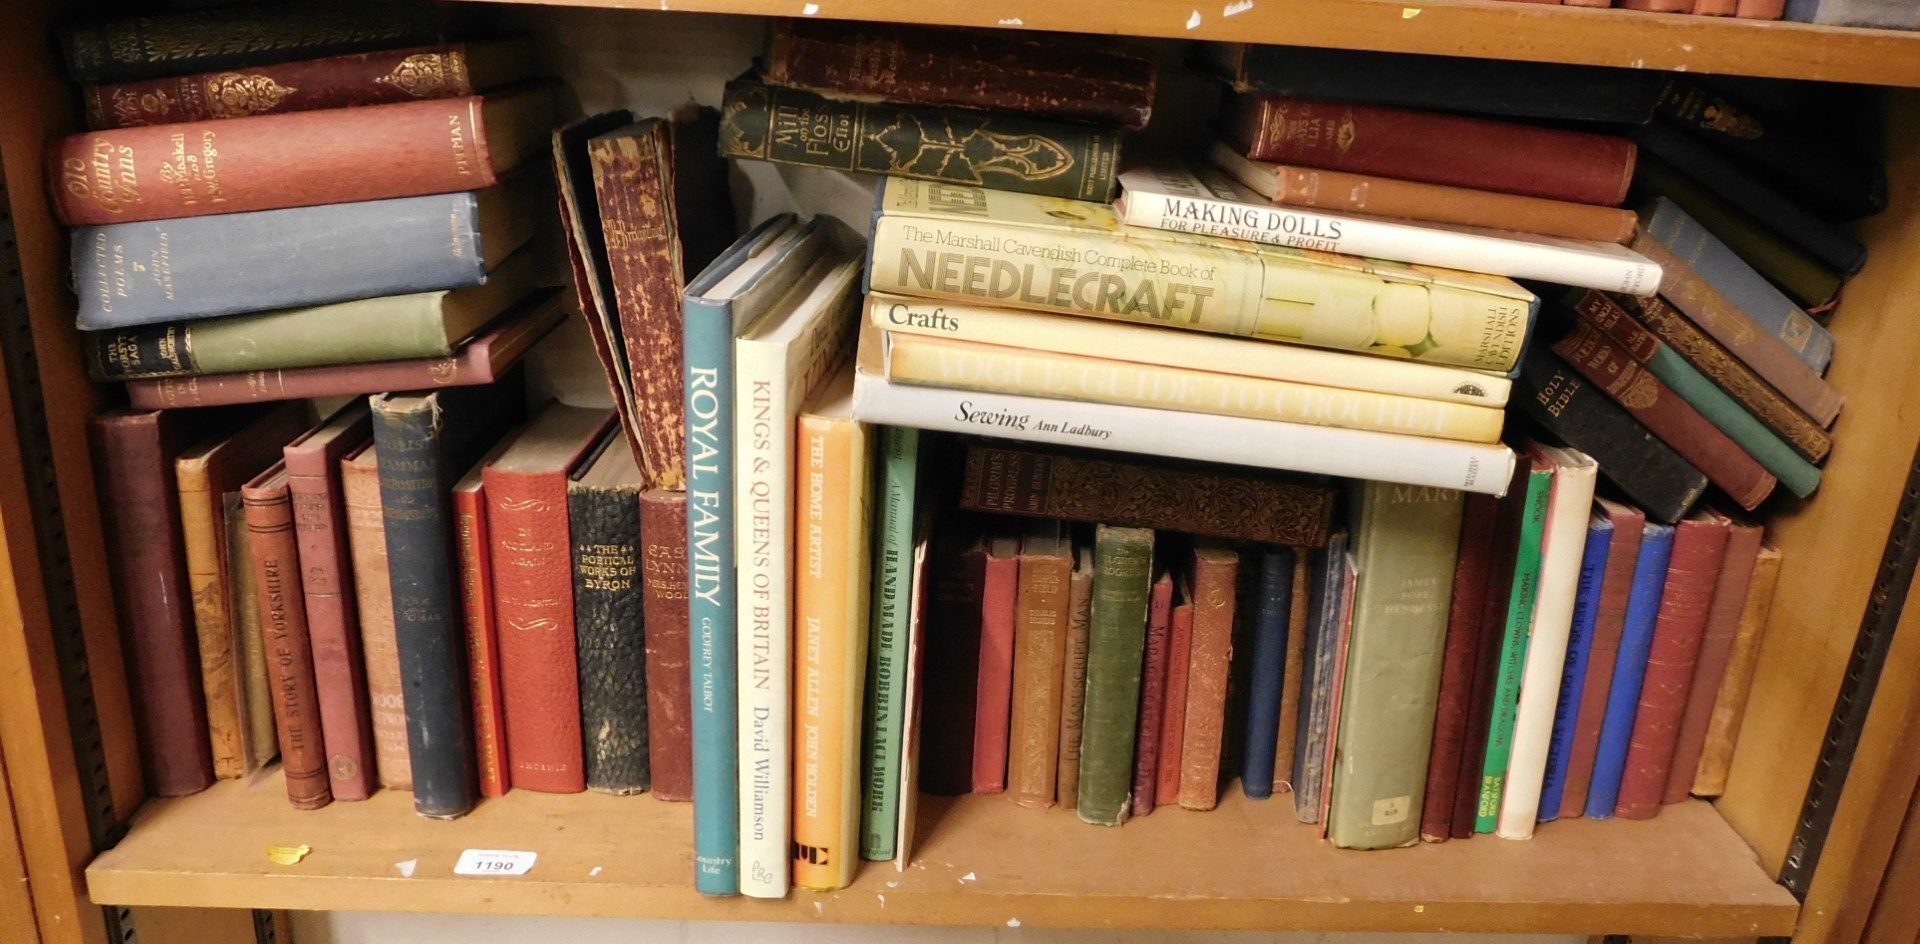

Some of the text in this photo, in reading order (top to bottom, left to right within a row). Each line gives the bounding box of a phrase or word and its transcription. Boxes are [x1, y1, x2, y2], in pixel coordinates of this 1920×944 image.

[448, 114, 471, 176] PITMAN
[775, 105, 799, 148] Mill
[799, 127, 810, 142] on
[1305, 117, 1322, 148] ELIA
[65, 157, 91, 199] Old
[92, 137, 124, 214] Country
[115, 145, 145, 204] Inns
[158, 160, 174, 184] By
[1160, 218, 1341, 251] FOR PLEASURE & PROFIT
[1162, 198, 1343, 240] MAKING DOLLS
[95, 232, 114, 313] COLLECTED
[113, 244, 129, 298] POEMS
[159, 232, 176, 302] MASEFIELD
[903, 224, 1216, 281] The Marshall Cavendish Complete Book of
[897, 246, 1216, 325] NEEDLECRAFT
[888, 303, 960, 332] Crafts
[1474, 306, 1498, 363] MARSHALL
[1485, 305, 1509, 367] CAVENDISH
[1498, 306, 1521, 368] EDITIONS
[117, 334, 134, 374] FORSYT
[127, 334, 142, 366] SAGA
[935, 350, 1455, 433] VOGUE GUIDE TO CROCHET
[1536, 369, 1566, 406] HOLY
[1547, 378, 1581, 419] BIBLE
[954, 400, 1113, 440] Sewing Ann Ladbury
[890, 480, 900, 491] A
[986, 453, 1005, 507] PILGRIM'S
[1002, 453, 1020, 510] PROGRESS
[887, 492, 900, 534] Manual
[1531, 490, 1545, 524] SNOOK
[581, 553, 634, 565] POETICAL
[593, 544, 620, 554] THE
[648, 544, 687, 558] EAS
[690, 366, 721, 713] ROYAL FAMILY GODFREY TALBOT
[886, 534, 898, 550] of
[579, 564, 637, 577] WORKS OF
[584, 577, 631, 592] BYRON
[645, 558, 689, 574] LYNN
[1103, 566, 1145, 577] ROGRESS
[1402, 577, 1439, 588] JAMES
[750, 380, 771, 841] KINGS & QUEENS OF BRITAIN David Williamson
[1516, 573, 1531, 613] MAKING
[804, 436, 825, 819] THE HOME ARTIST JANET ALLEN JOHN HOLDEN
[264, 558, 304, 751] THE STORY OF YORKSHIRE
[1506, 652, 1519, 686] WITCHES
[876, 656, 891, 724] BOBBIN
[1064, 598, 1090, 762] THE MANUSCRIPT MAN
[1503, 687, 1513, 706] AND
[1544, 563, 1596, 790] THE REIGN OF QUEEN VICTORIA
[1495, 706, 1510, 748] DRAGONS
[872, 767, 886, 812] WORK
[1477, 775, 1493, 818] BRANFORD
[1487, 777, 1501, 817] BATSFORD
[475, 861, 514, 871] 1190
[702, 864, 721, 875] Life
